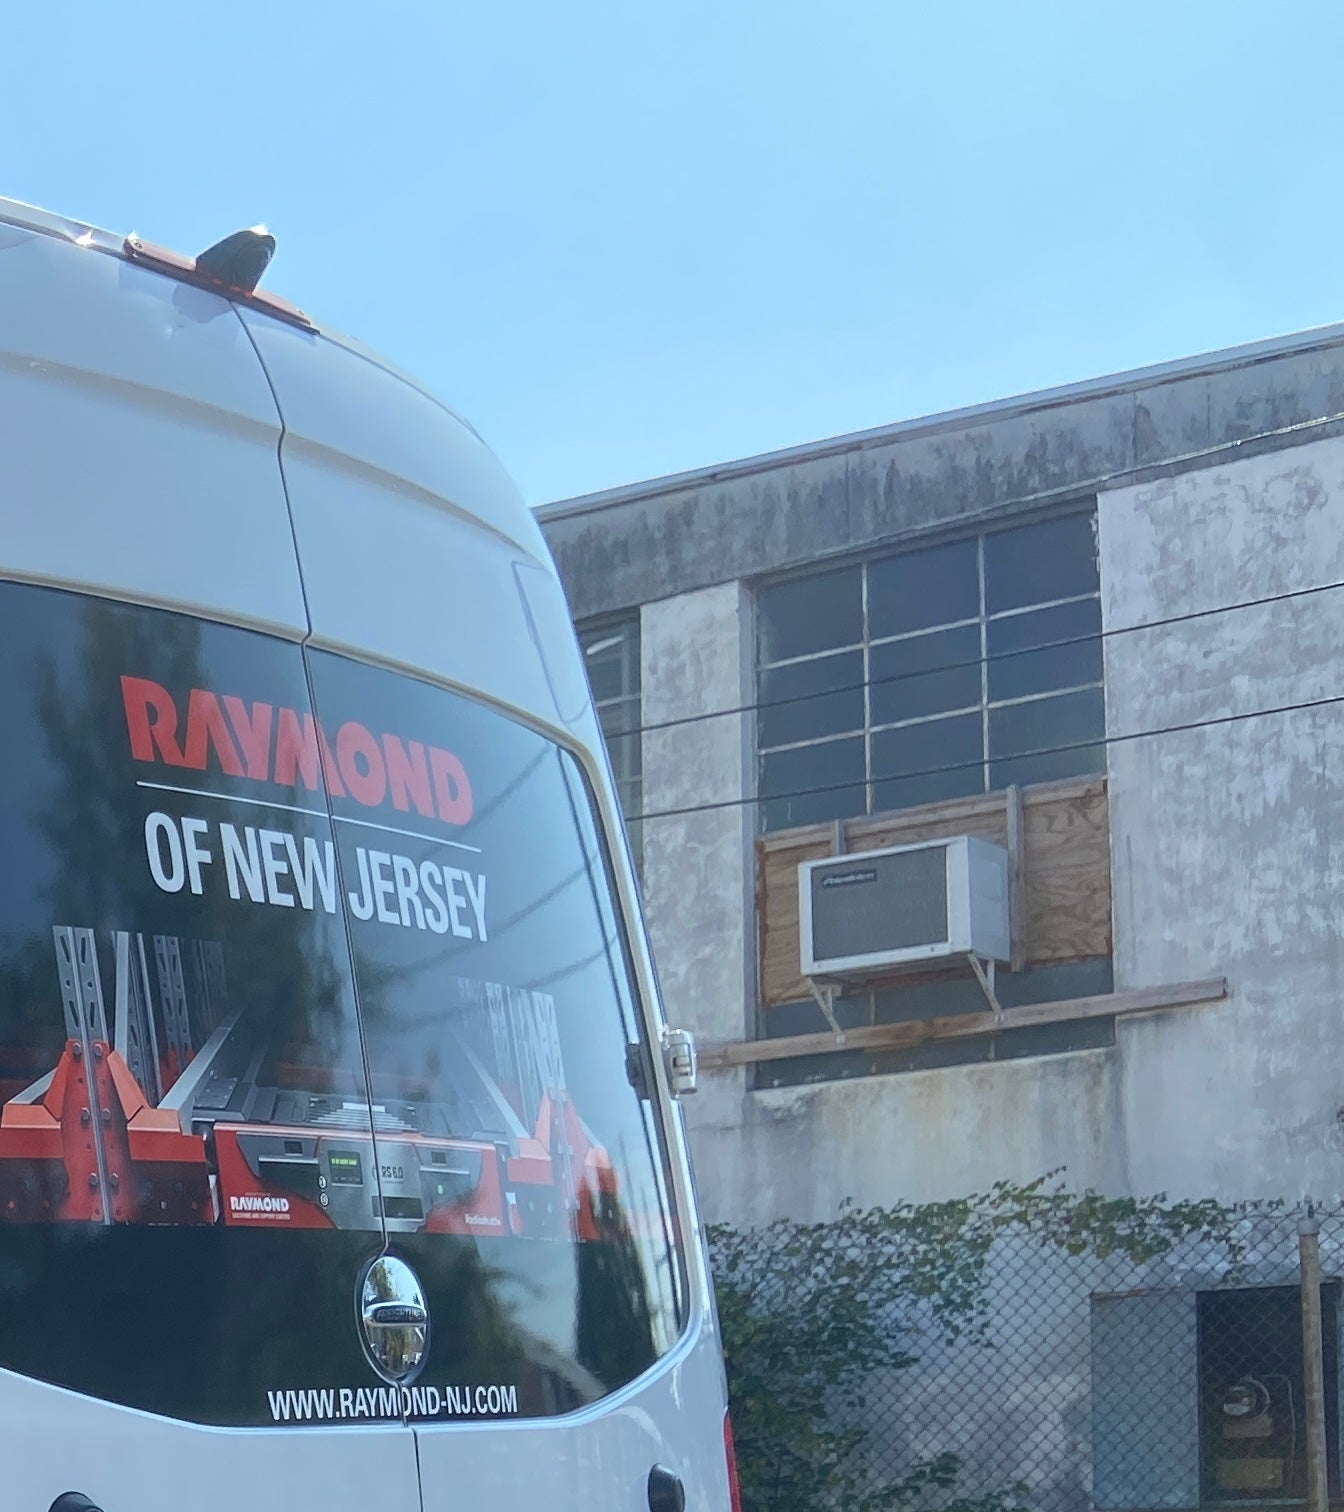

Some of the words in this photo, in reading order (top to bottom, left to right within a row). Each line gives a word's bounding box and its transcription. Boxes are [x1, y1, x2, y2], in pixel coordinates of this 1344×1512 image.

[121, 675, 473, 826] RAYMOND
[144, 811, 213, 897] OF
[221, 821, 336, 914] NEW
[349, 844, 488, 942] JERSEY
[229, 1196, 290, 1212] RAYMOND
[267, 1385, 518, 1420] WWW.RAYMOND-NJ.COM
